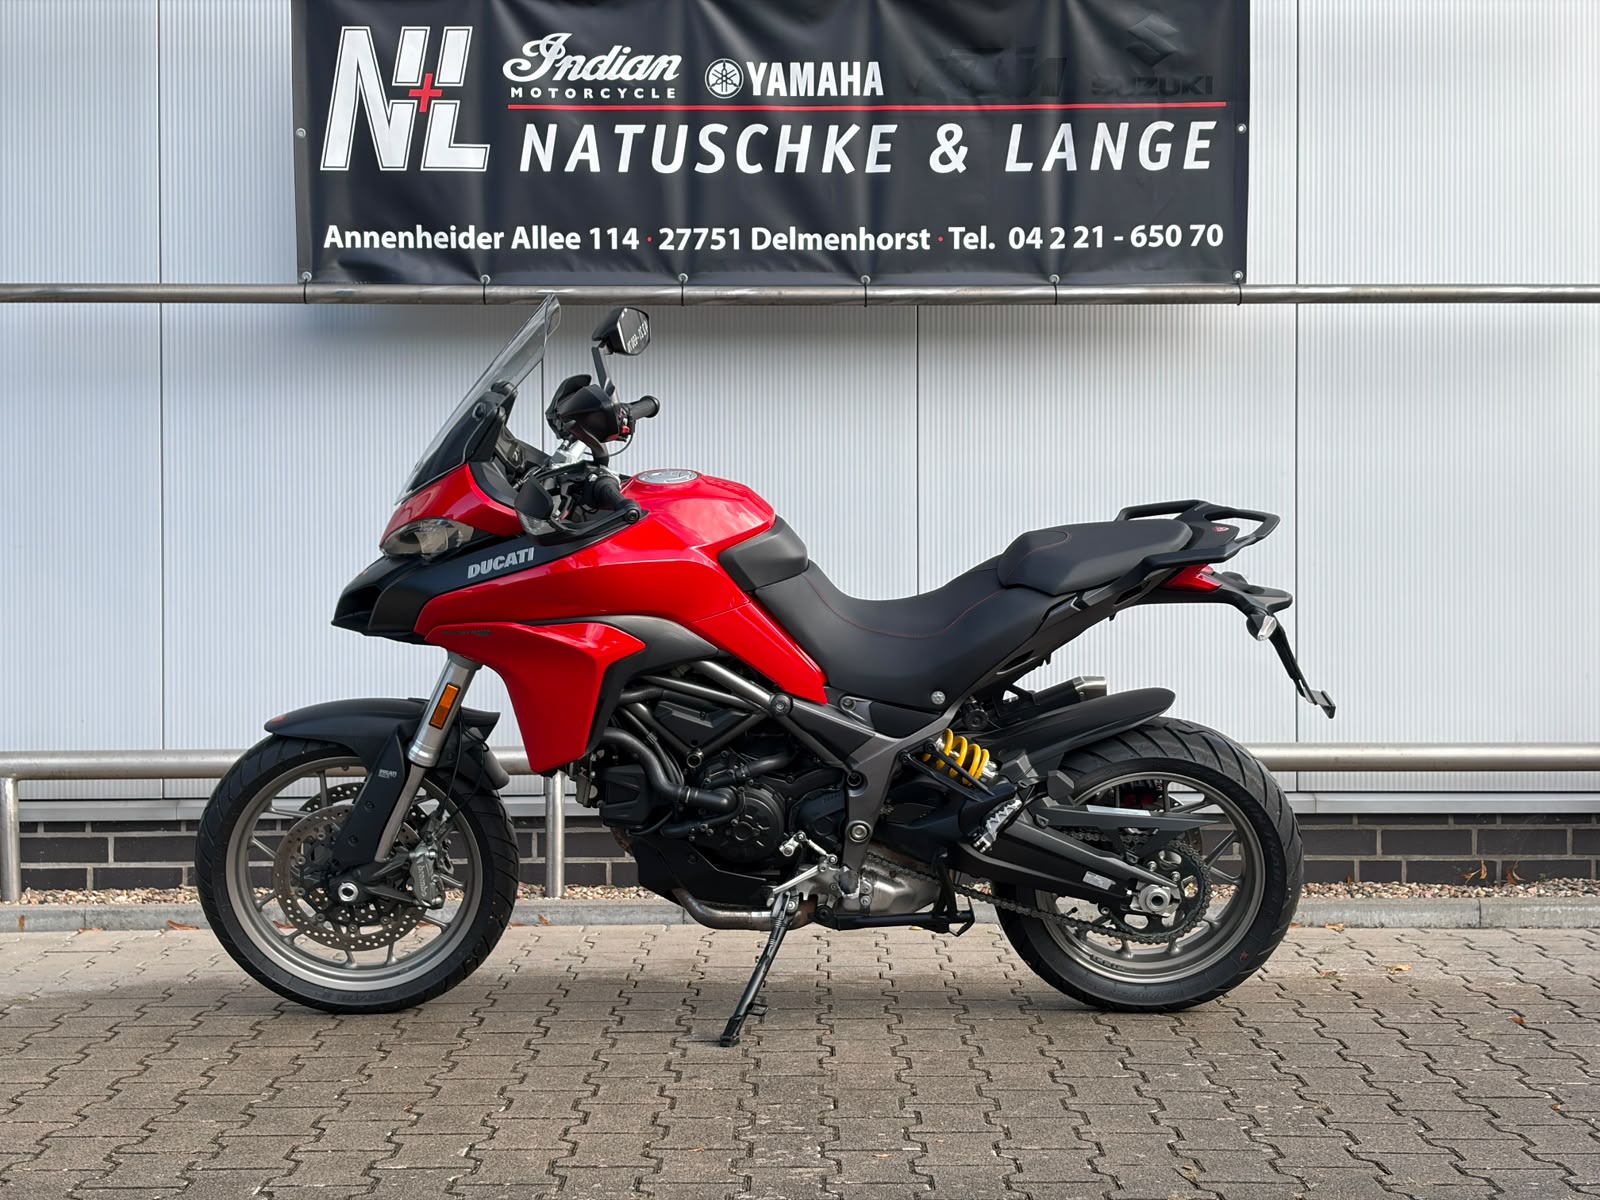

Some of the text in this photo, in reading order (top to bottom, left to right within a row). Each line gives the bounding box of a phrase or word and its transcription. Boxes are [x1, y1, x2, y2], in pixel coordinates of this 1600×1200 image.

[502, 32, 683, 83] Indian
[510, 87, 676, 99] MOTORCYCLE
[746, 61, 884, 97] YAMAHA
[519, 120, 1217, 174] NATUSCHKE & LANGE
[323, 224, 505, 250] Annenheider
[510, 224, 582, 250] Allee
[589, 227, 640, 250] 114
[658, 227, 740, 251] 27751
[751, 226, 931, 251] Delmenhorst
[948, 226, 996, 250] Tel.
[467, 546, 535, 579] DUCATI
[416, 864, 428, 898] brembo
